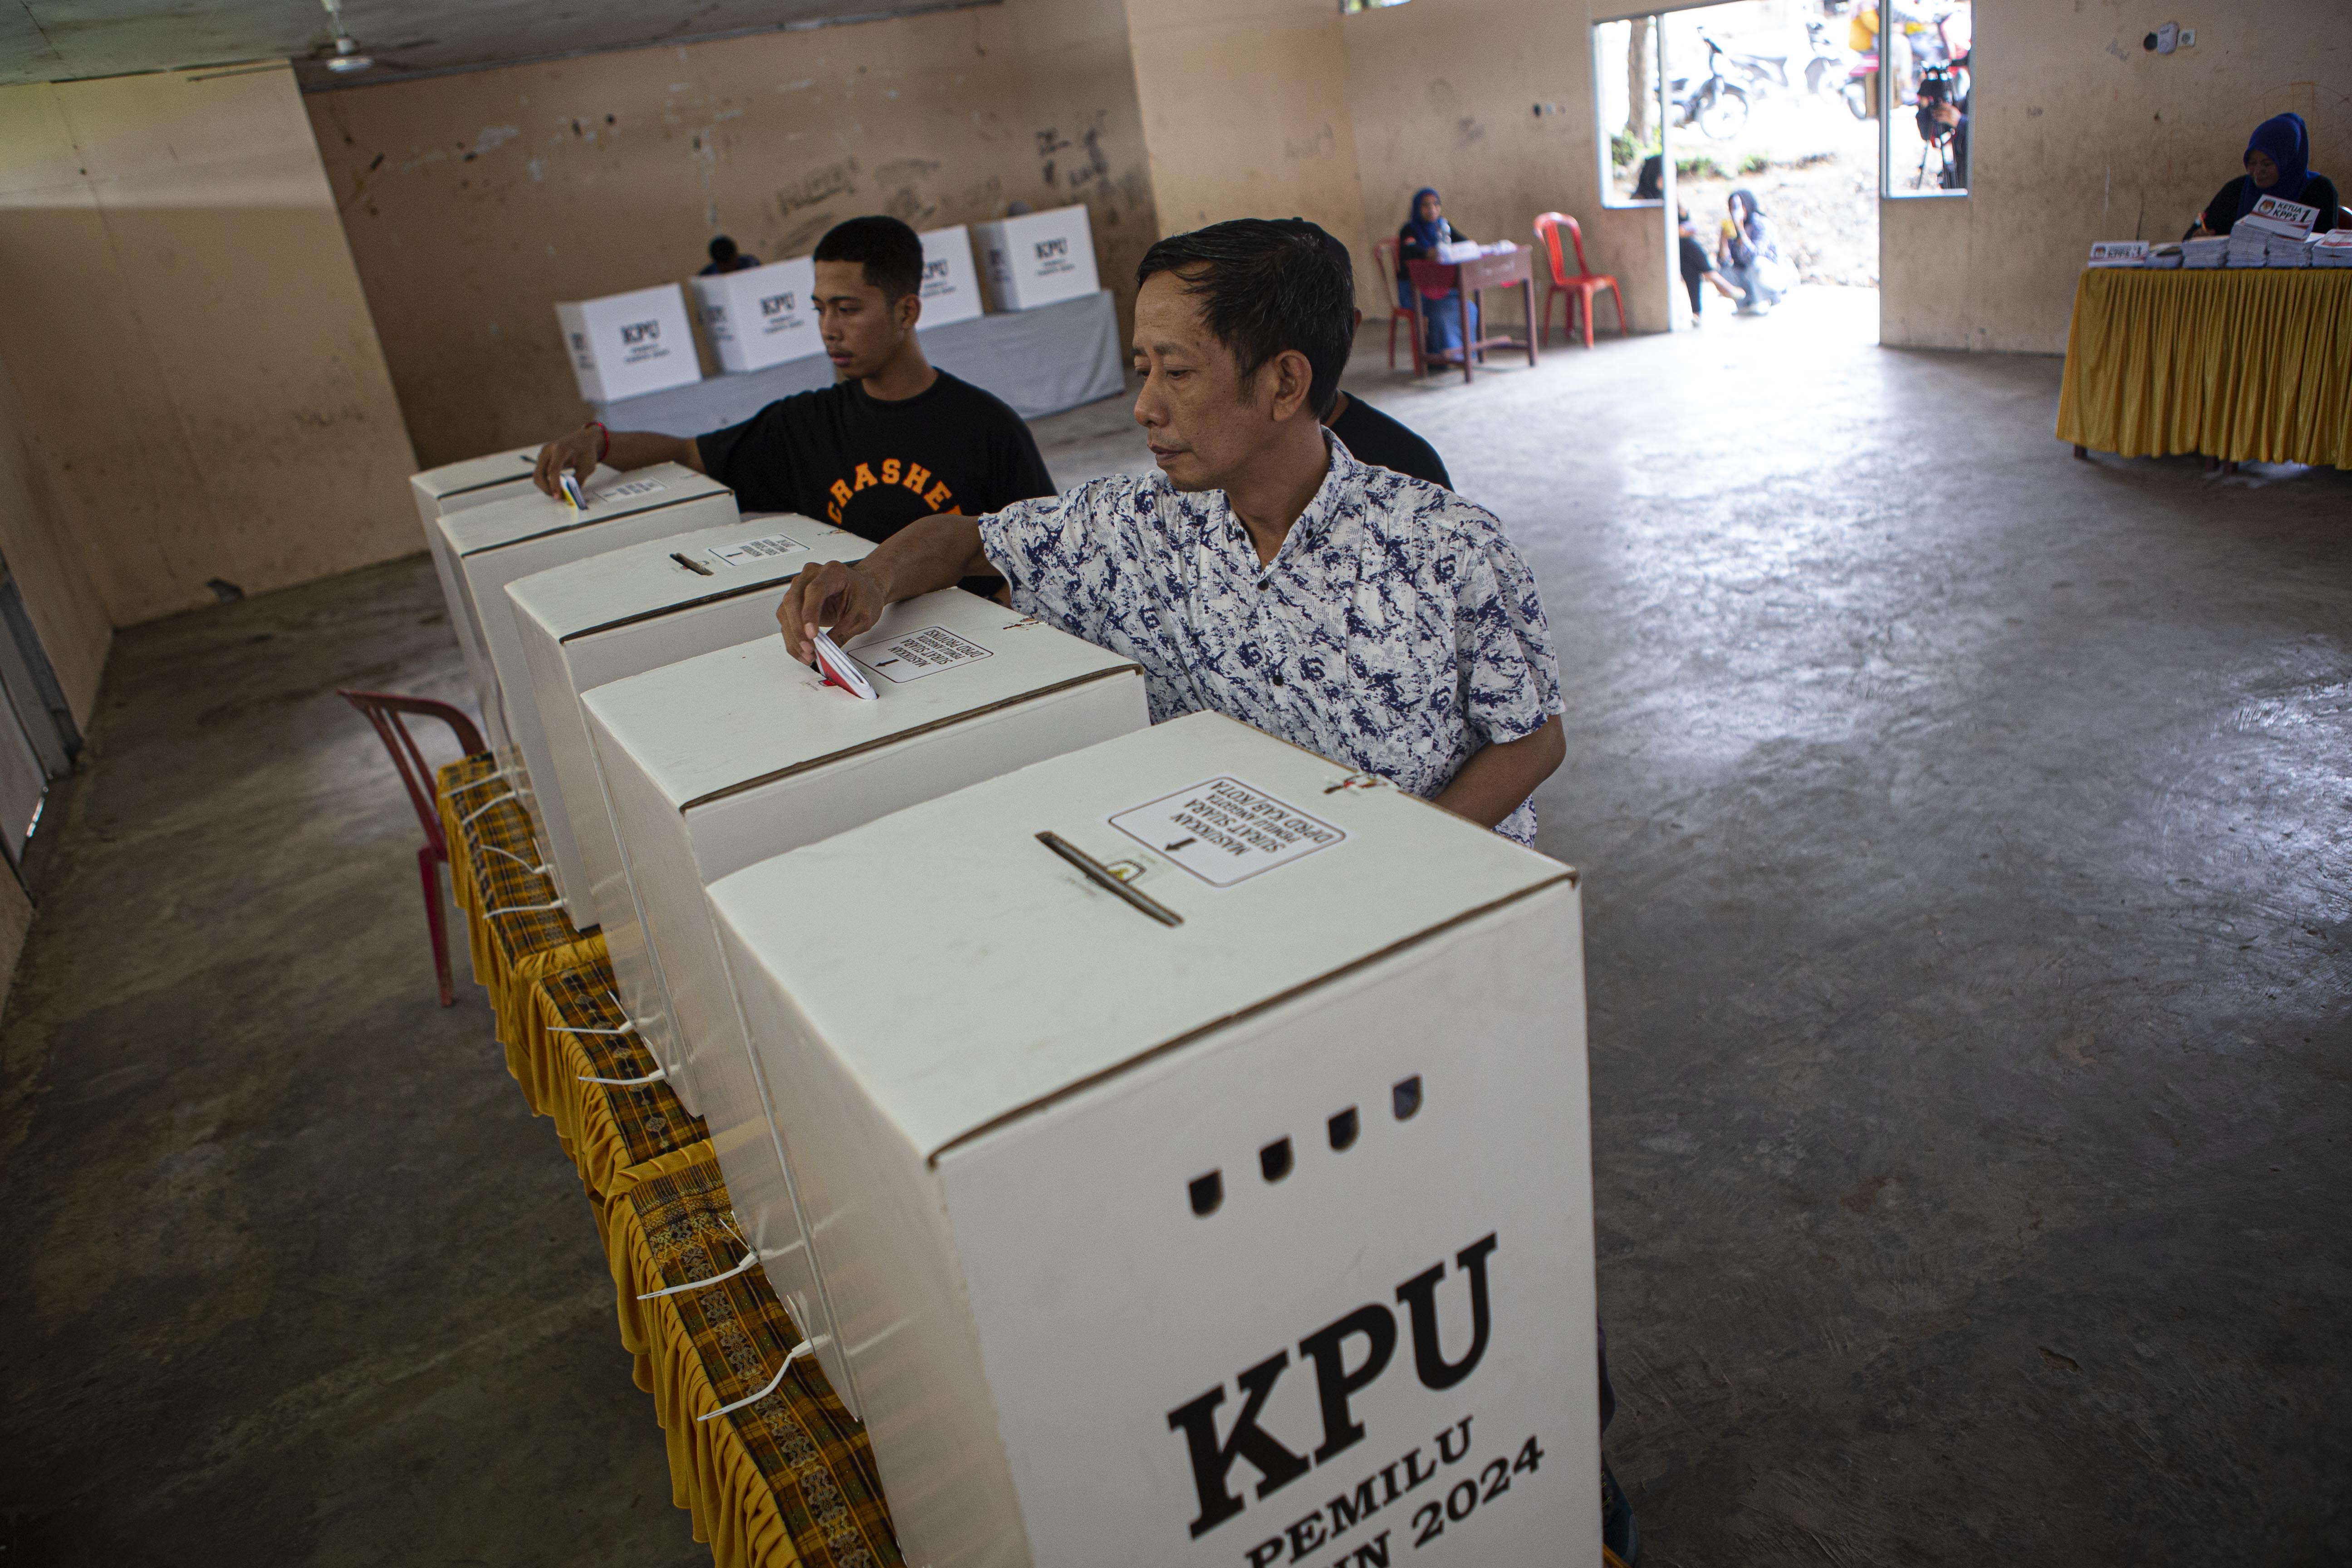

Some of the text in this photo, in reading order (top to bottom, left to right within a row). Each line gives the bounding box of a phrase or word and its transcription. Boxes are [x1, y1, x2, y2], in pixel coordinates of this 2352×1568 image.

[2273, 208, 2298, 221] KPPS
[2278, 202, 2302, 214] KETUA
[1034, 236, 1068, 259] KPU
[760, 291, 794, 316] KPU
[620, 318, 661, 344] KPU
[887, 646, 931, 667] MASUKKAN
[900, 638, 953, 665] SURAT SUARA
[916, 635, 965, 660] PEMILU ANGGOTA
[923, 629, 985, 658] DPRD PROVINSI
[1184, 799, 1286, 853] SURAT SUARA
[1205, 794, 1301, 843] PEMILU ANGGOTA
[1210, 781, 1334, 844] DPRD KAB/KOTA
[1170, 813, 1251, 856] MASUKKAN
[1167, 1231, 1498, 1541] KPU
[1245, 1415, 1474, 1568] PEMILU
[1411, 1435, 1545, 1549] 2024
